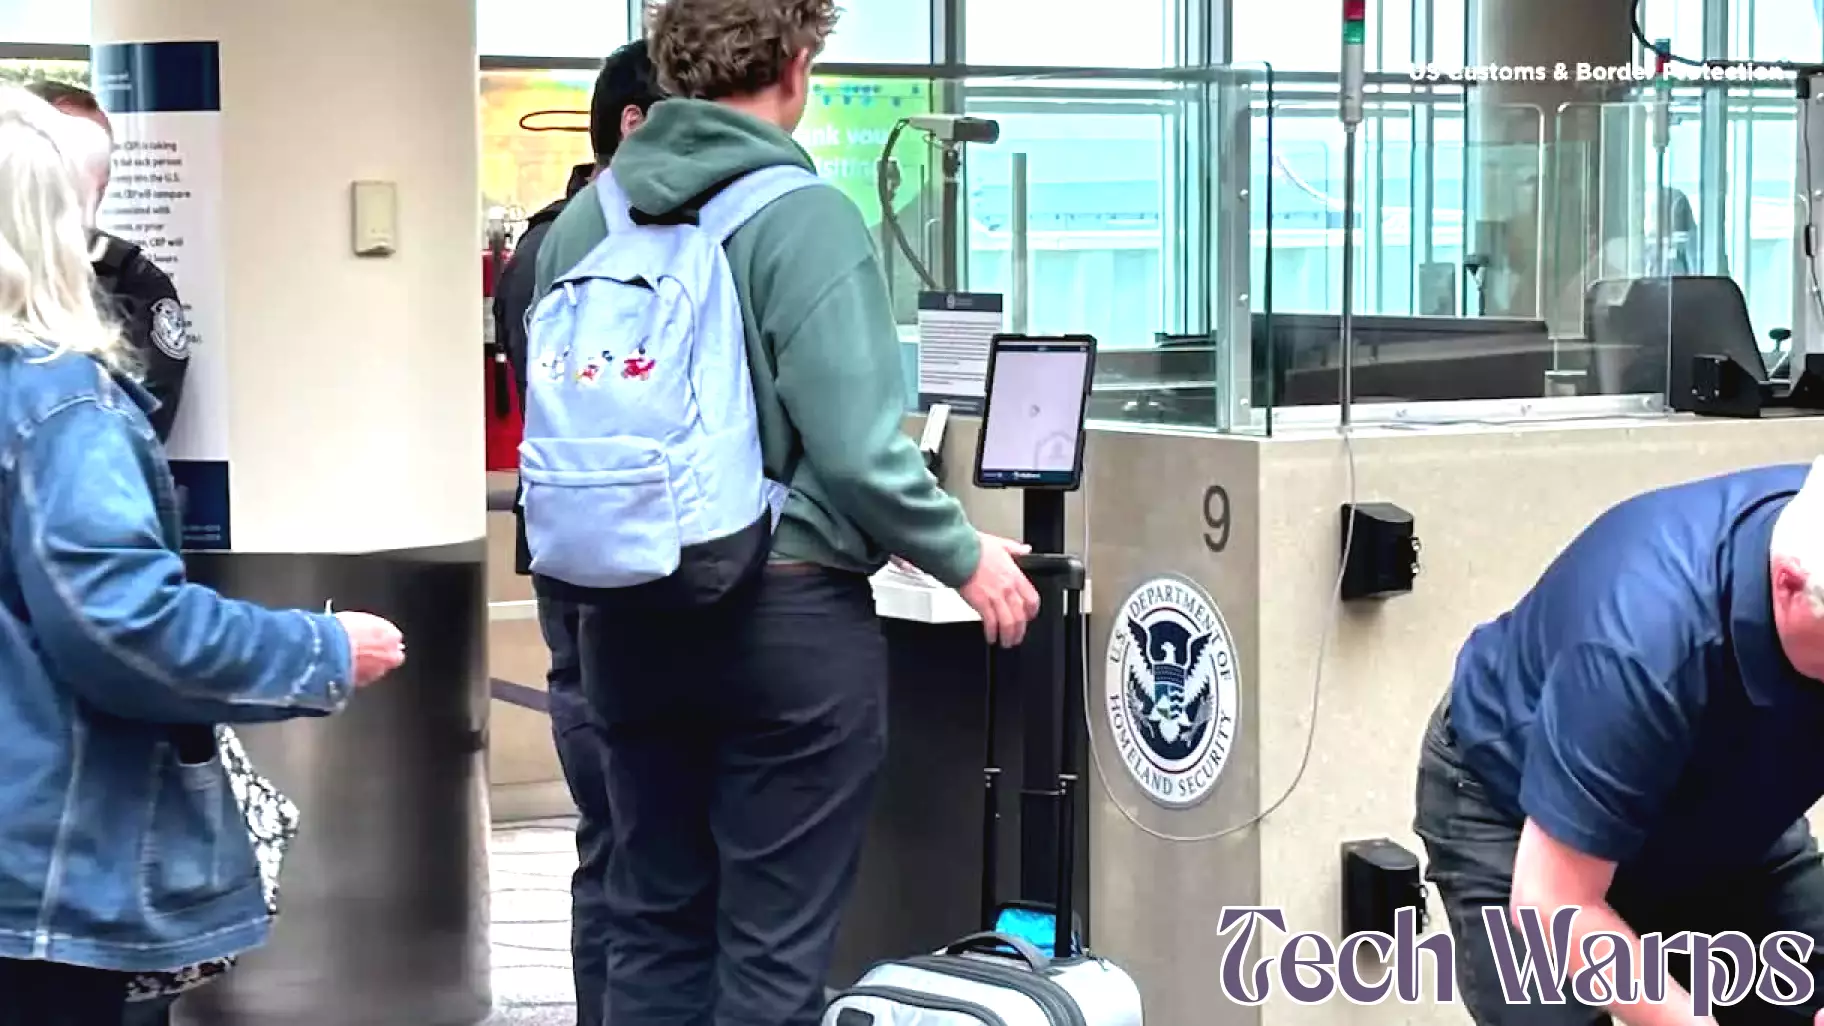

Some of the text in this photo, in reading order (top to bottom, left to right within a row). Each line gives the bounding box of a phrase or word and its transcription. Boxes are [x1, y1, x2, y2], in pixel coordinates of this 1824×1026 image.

[1203, 485, 1231, 552] 9
[1129, 584, 1222, 645] DEPARTMENT
[1216, 650, 1233, 680] OF
[1109, 694, 1232, 797] HOMELAND SECURITY
